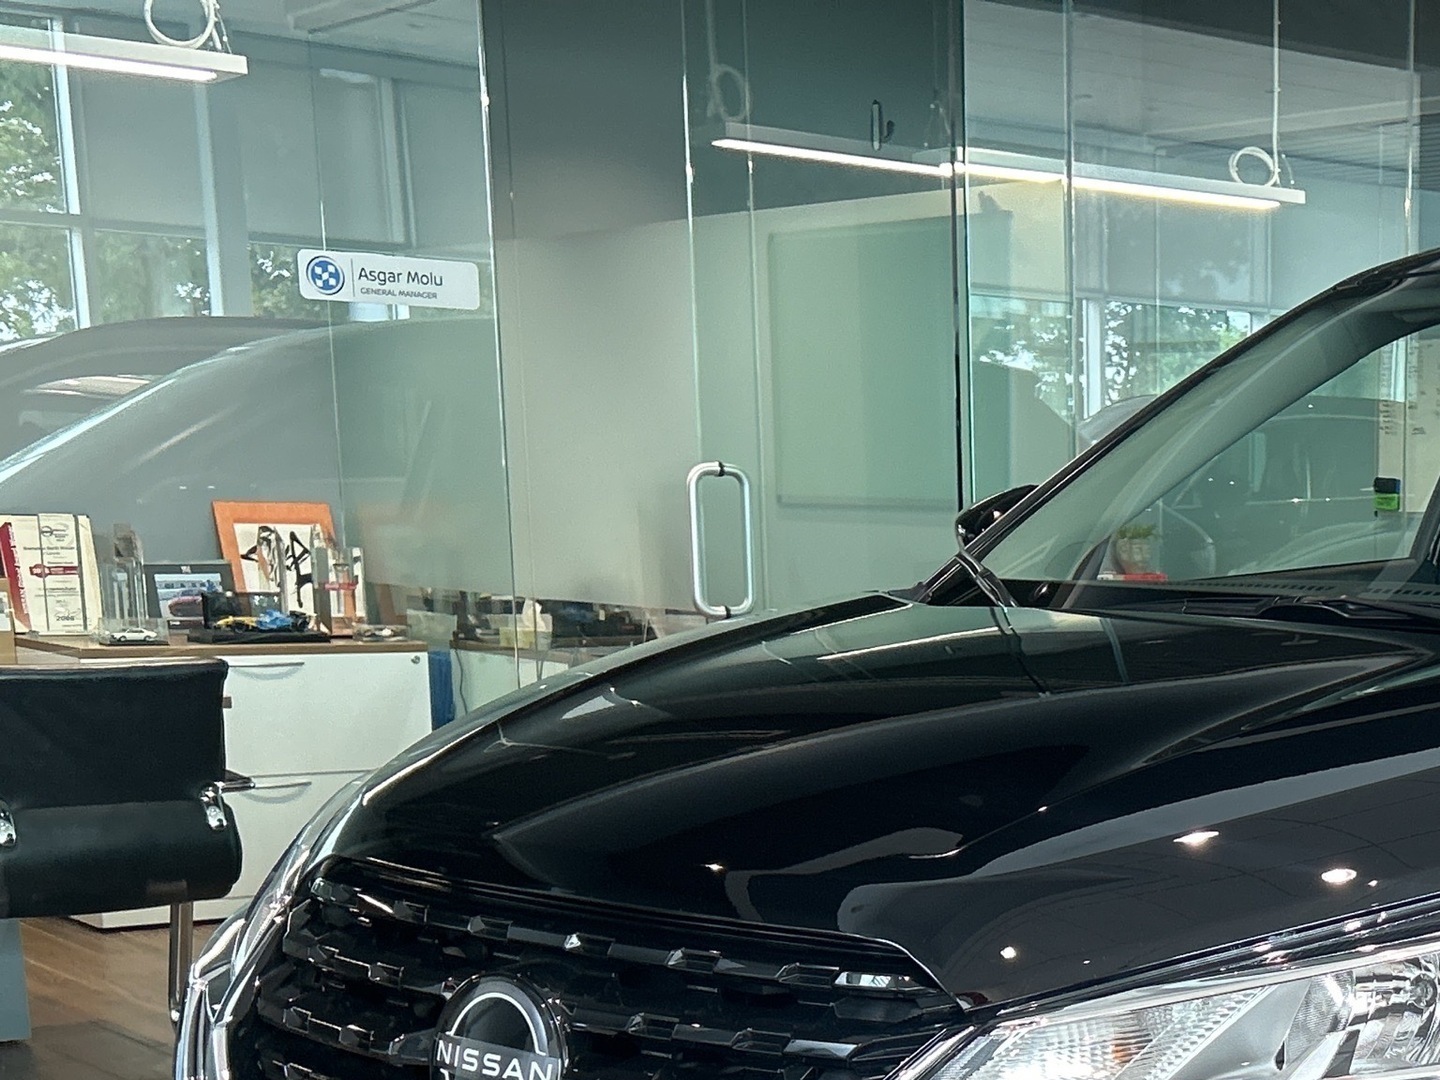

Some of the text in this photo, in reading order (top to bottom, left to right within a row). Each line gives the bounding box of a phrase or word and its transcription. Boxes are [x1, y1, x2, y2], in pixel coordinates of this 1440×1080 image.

[358, 267, 443, 287] Asgar Molu
[360, 287, 438, 300] GENERAL MANAGER
